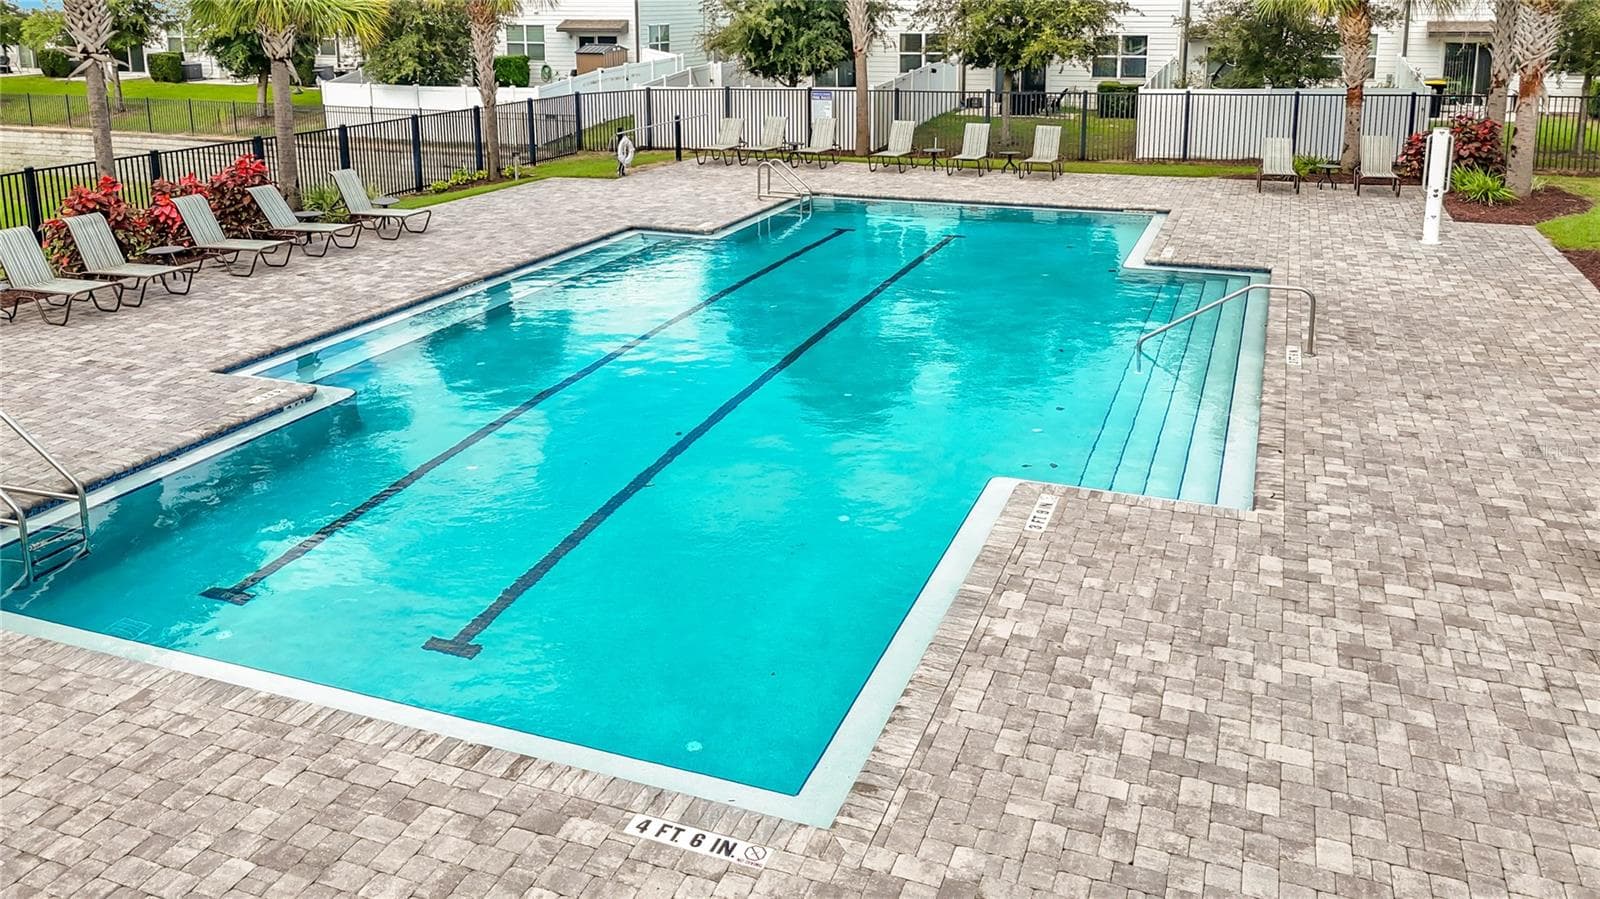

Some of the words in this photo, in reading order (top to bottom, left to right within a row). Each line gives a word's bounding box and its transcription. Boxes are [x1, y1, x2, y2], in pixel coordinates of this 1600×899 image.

[635, 819, 652, 834] 4
[654, 823, 686, 843] FT.
[689, 833, 706, 848] 6
[709, 838, 738, 858] IN.
